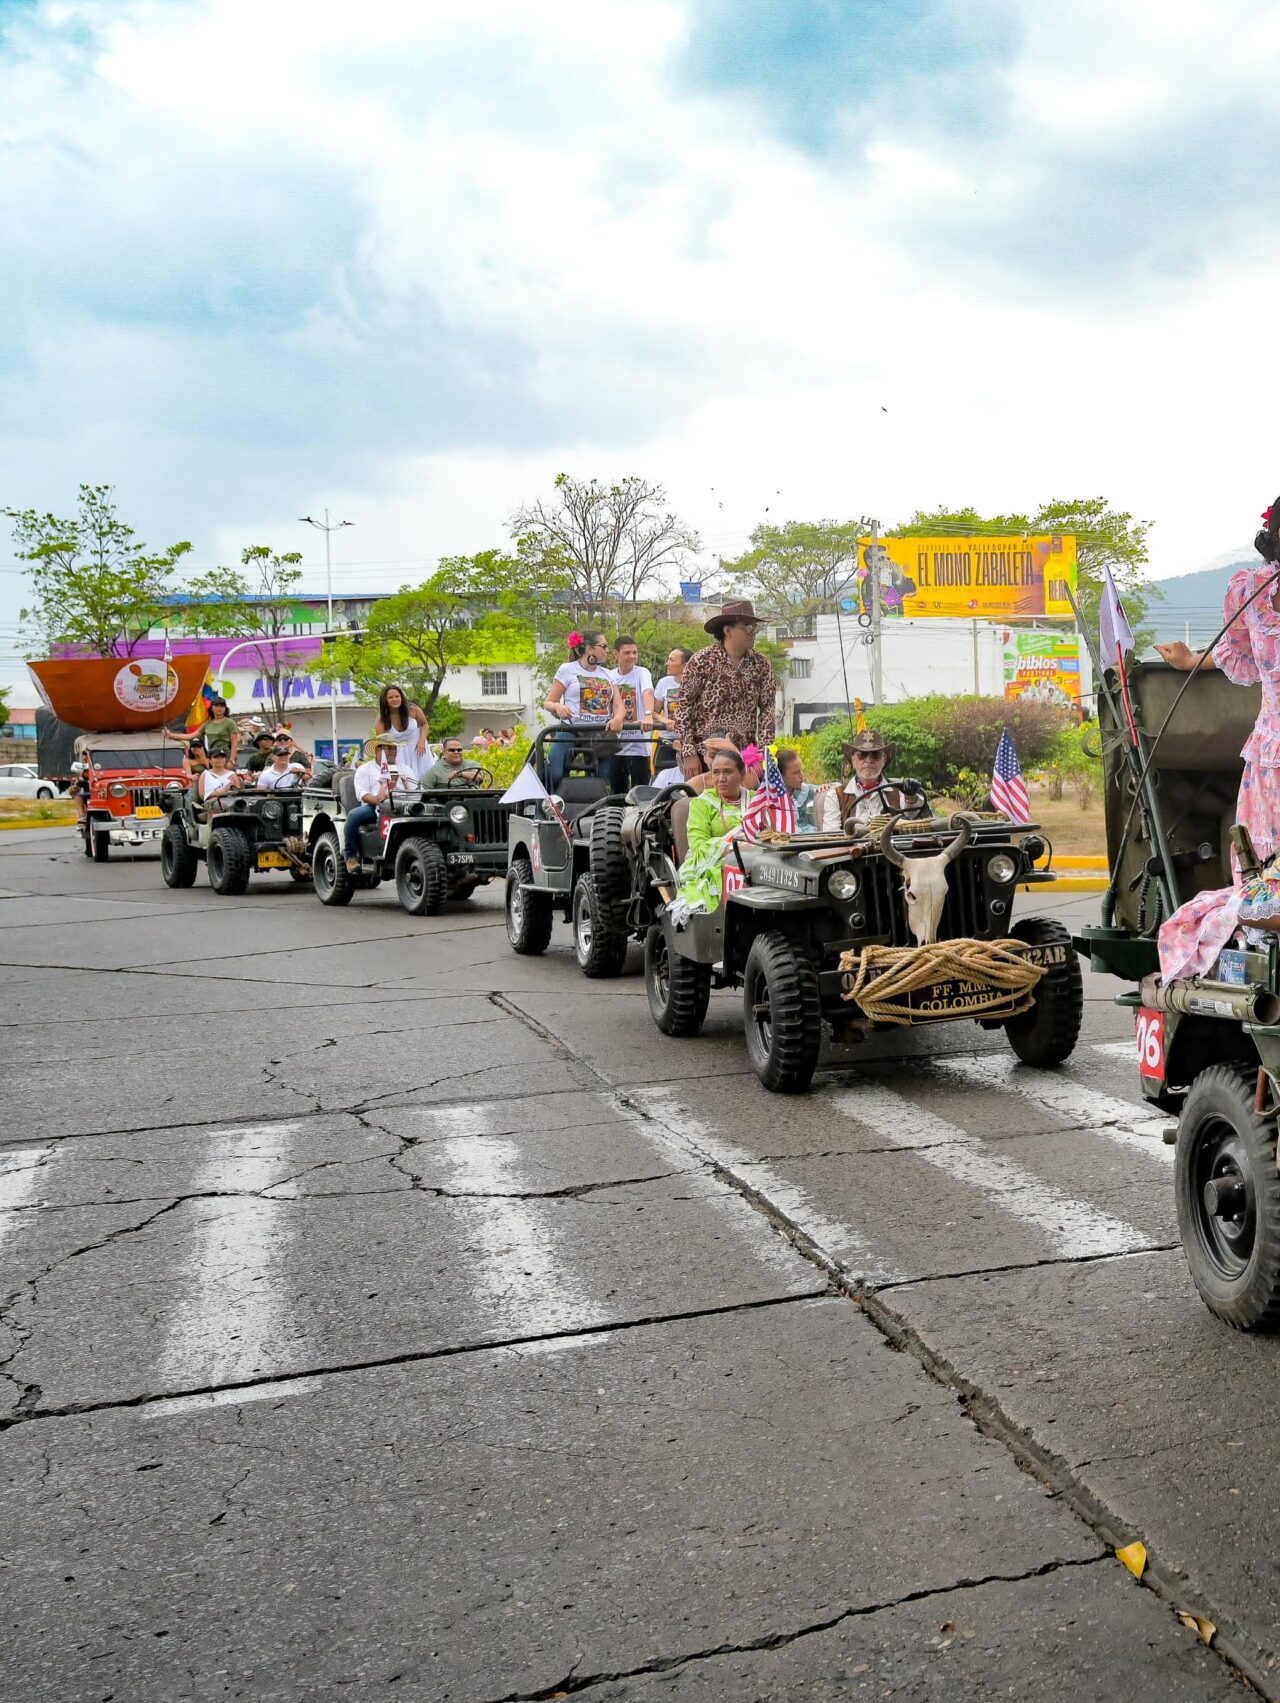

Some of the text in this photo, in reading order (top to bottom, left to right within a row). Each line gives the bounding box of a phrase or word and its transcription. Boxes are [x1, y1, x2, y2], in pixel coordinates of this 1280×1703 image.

[918, 551, 1034, 587] EL MONO ZABALETA
[920, 991, 1004, 1012] COLOMBIA
[932, 982, 991, 998] FF. MM.
[1136, 1015, 1161, 1068] 06
